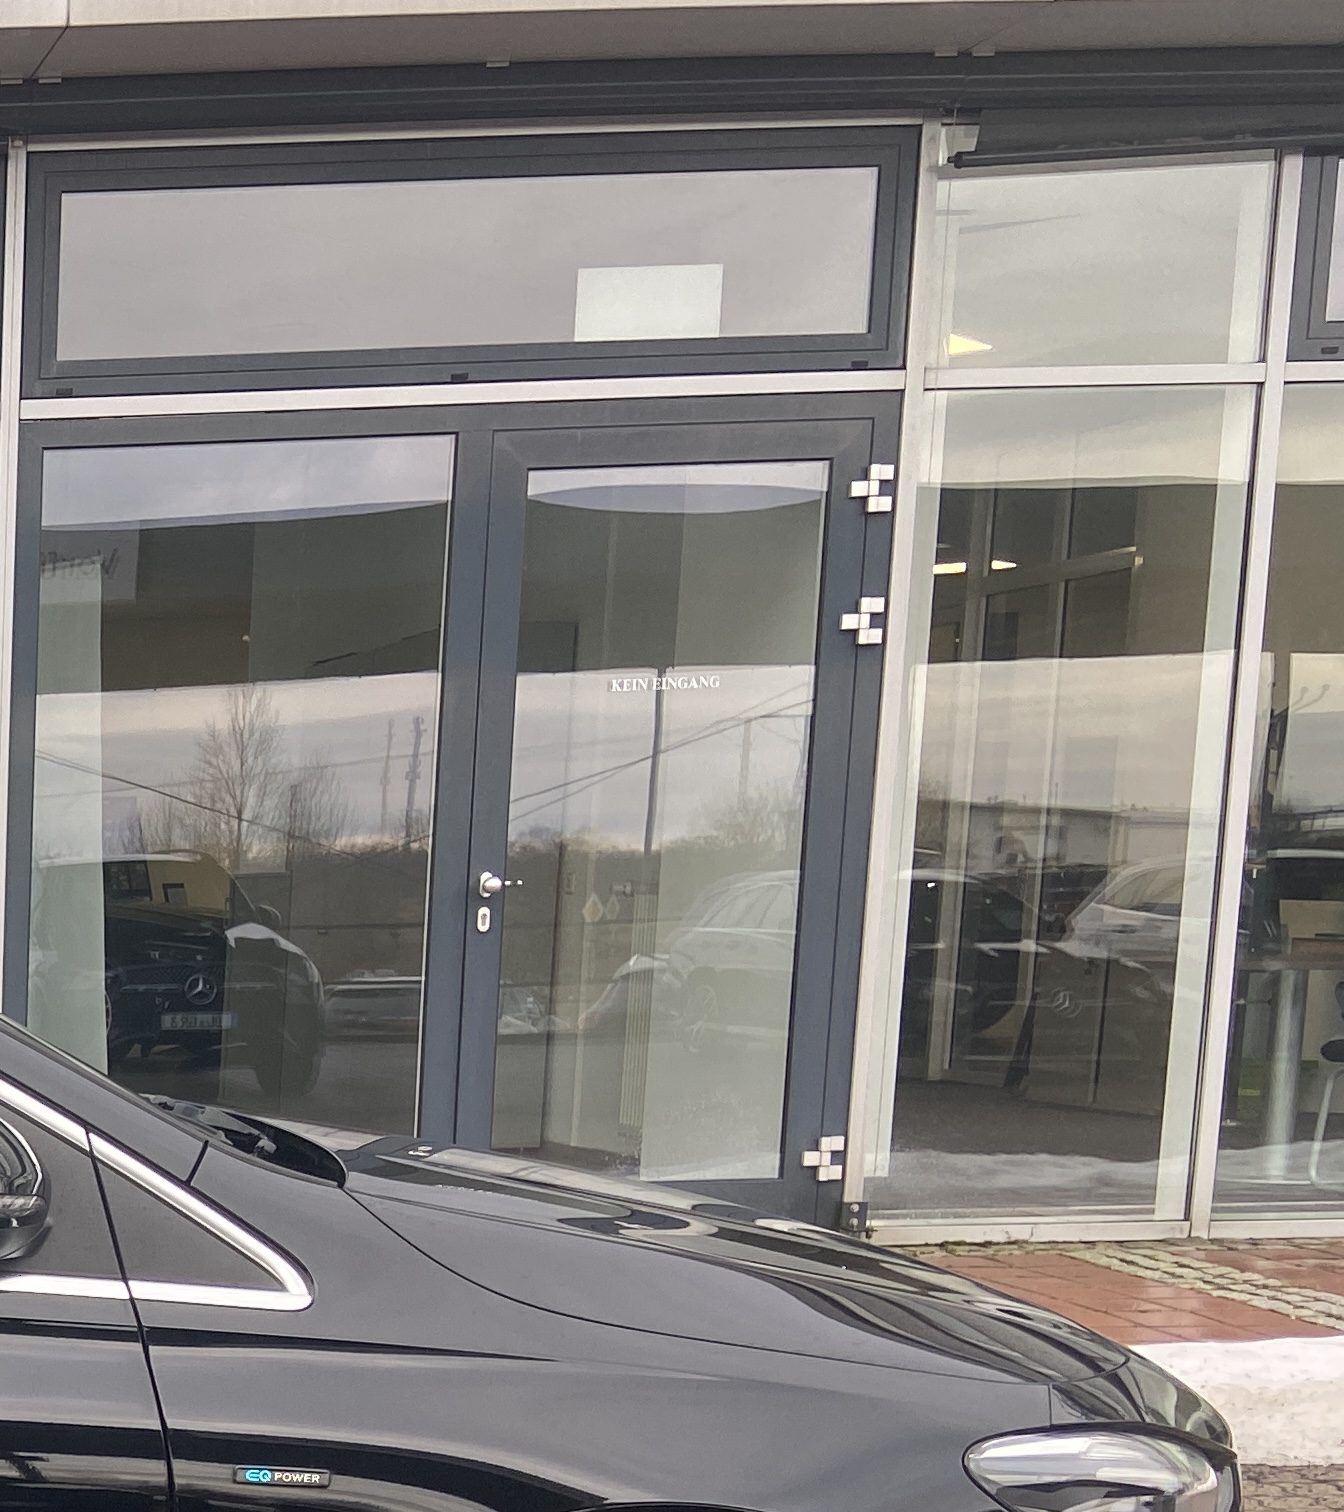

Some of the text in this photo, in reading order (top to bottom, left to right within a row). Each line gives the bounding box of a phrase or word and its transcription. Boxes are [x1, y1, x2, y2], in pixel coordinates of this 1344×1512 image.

[611, 675, 720, 692] KEIN EINGANG
[245, 1469, 321, 1484] EQ POWER
